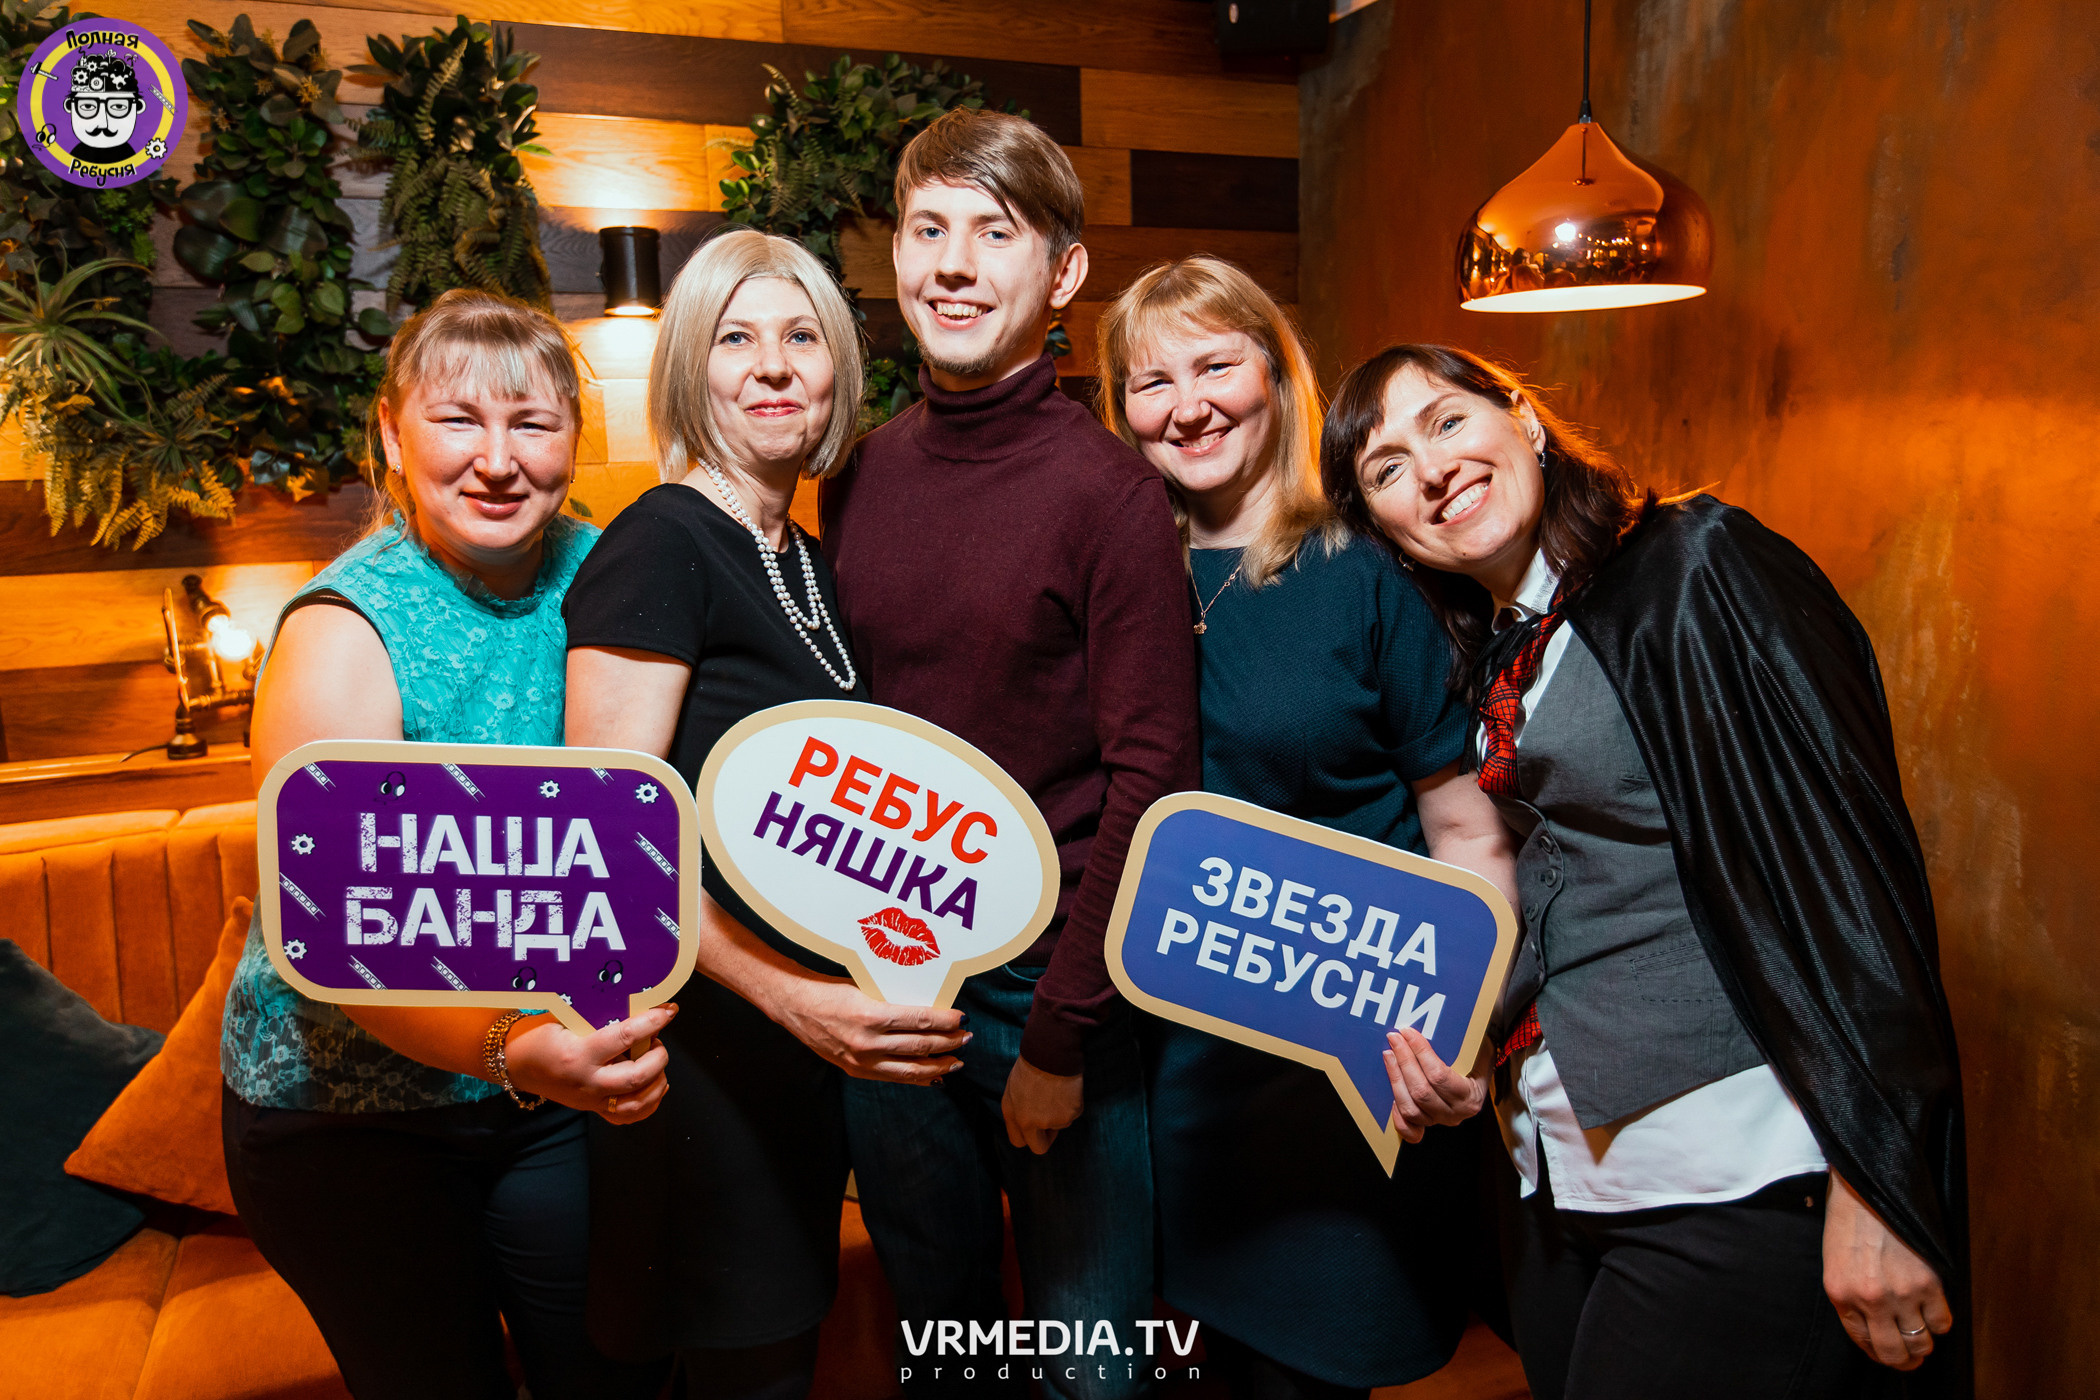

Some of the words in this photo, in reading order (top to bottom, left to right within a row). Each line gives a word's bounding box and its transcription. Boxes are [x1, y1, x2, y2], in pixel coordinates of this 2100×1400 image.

[360, 812, 610, 878] НАША
[753, 790, 978, 931] НЯШКА
[788, 736, 998, 864] РЕБУС
[345, 886, 627, 962] БАНДА
[1156, 907, 1447, 1040] РЕБУСНИ
[1192, 856, 1437, 976] ЗВЕЗДА
